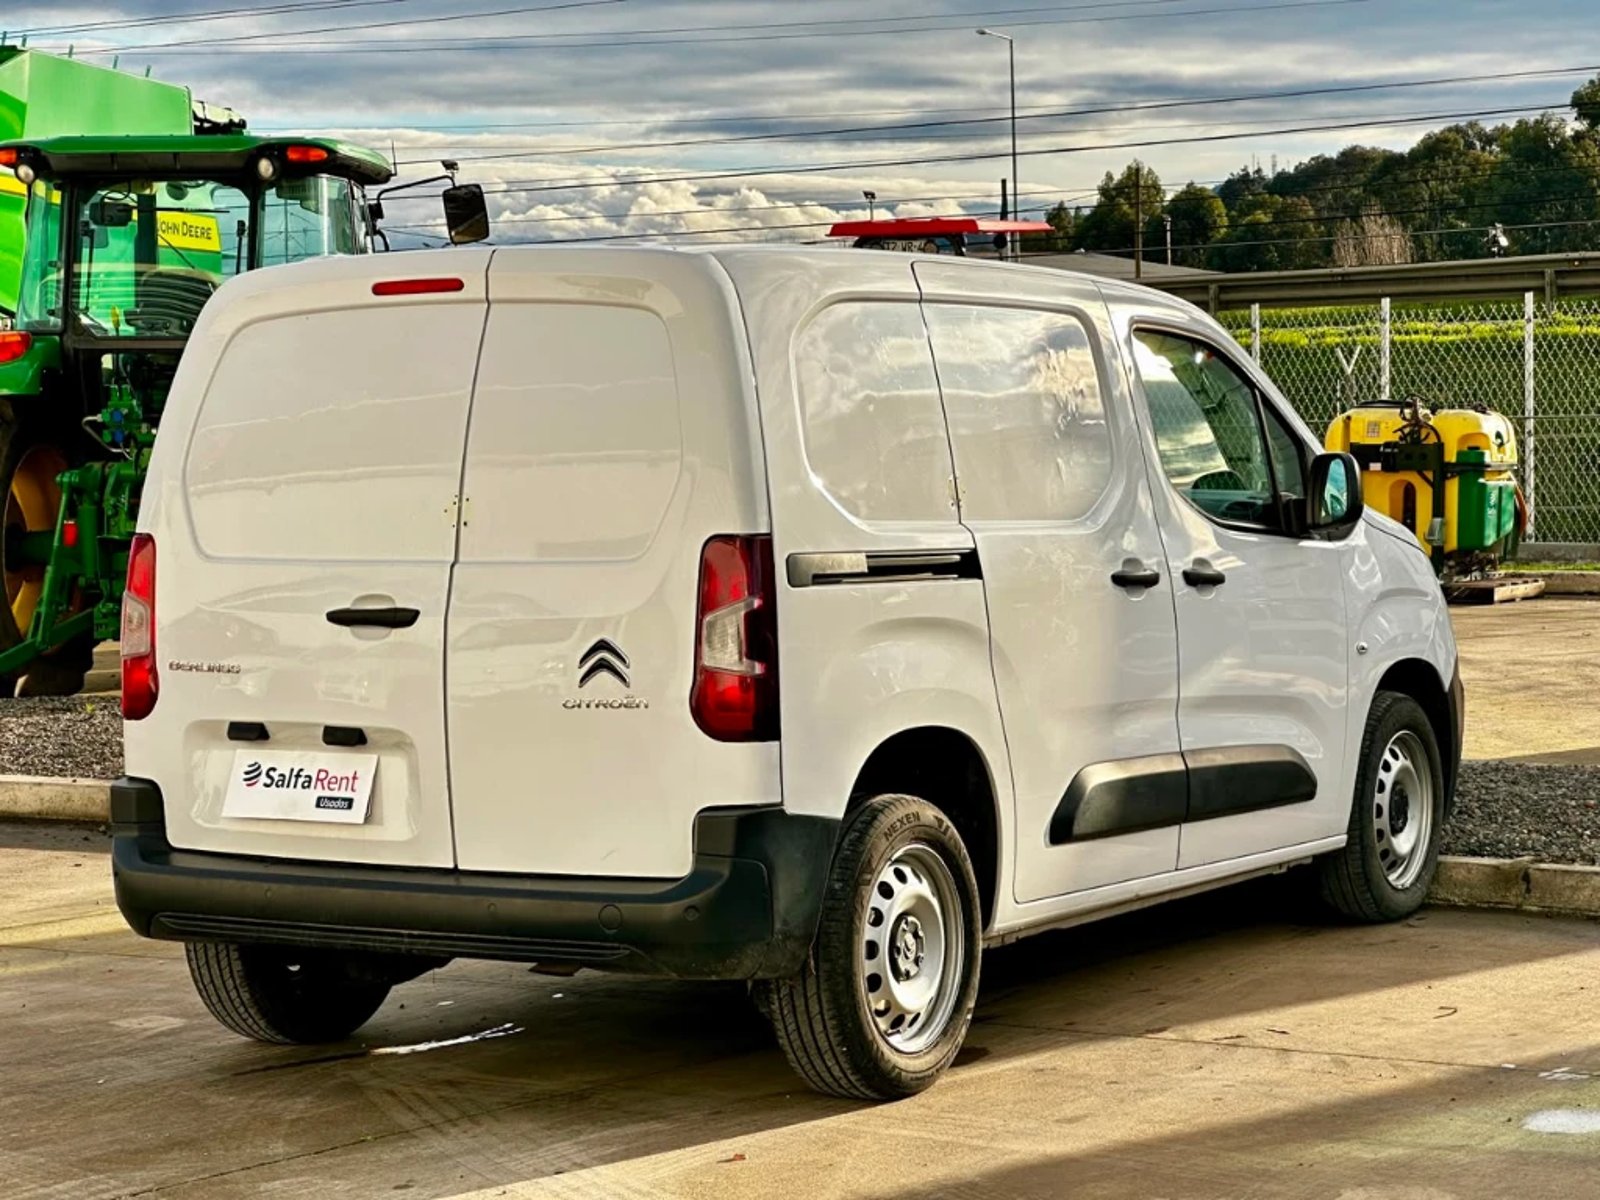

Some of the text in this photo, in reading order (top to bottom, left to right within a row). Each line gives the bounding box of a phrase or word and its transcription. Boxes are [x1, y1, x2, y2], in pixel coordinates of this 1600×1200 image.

[157, 220, 180, 236] OHN
[262, 766, 360, 793] SalfaRent
[319, 797, 349, 809] Usados
[882, 810, 921, 841] NEXEN
